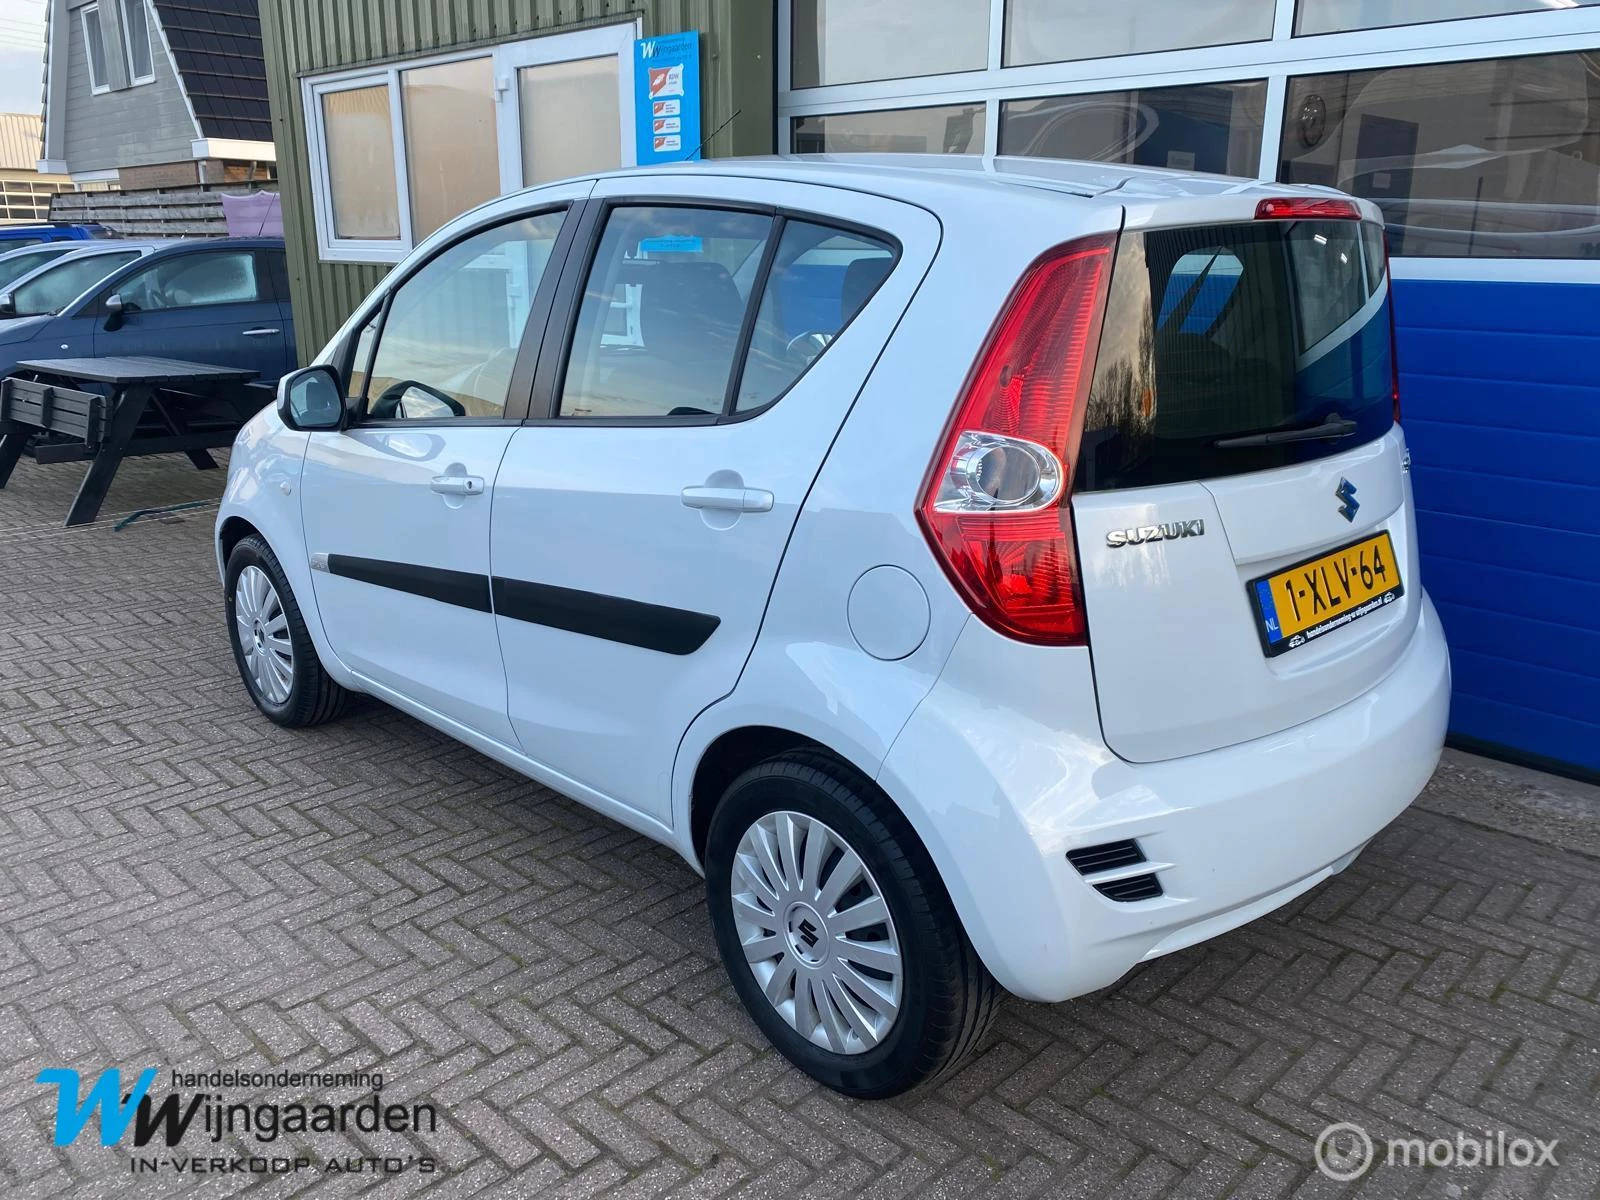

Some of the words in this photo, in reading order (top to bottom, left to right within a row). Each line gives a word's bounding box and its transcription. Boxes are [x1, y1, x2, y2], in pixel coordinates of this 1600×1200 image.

[1106, 519, 1205, 548] SUZUKI
[1284, 545, 1386, 622] 1-XLV-64
[1265, 617, 1279, 633] NL
